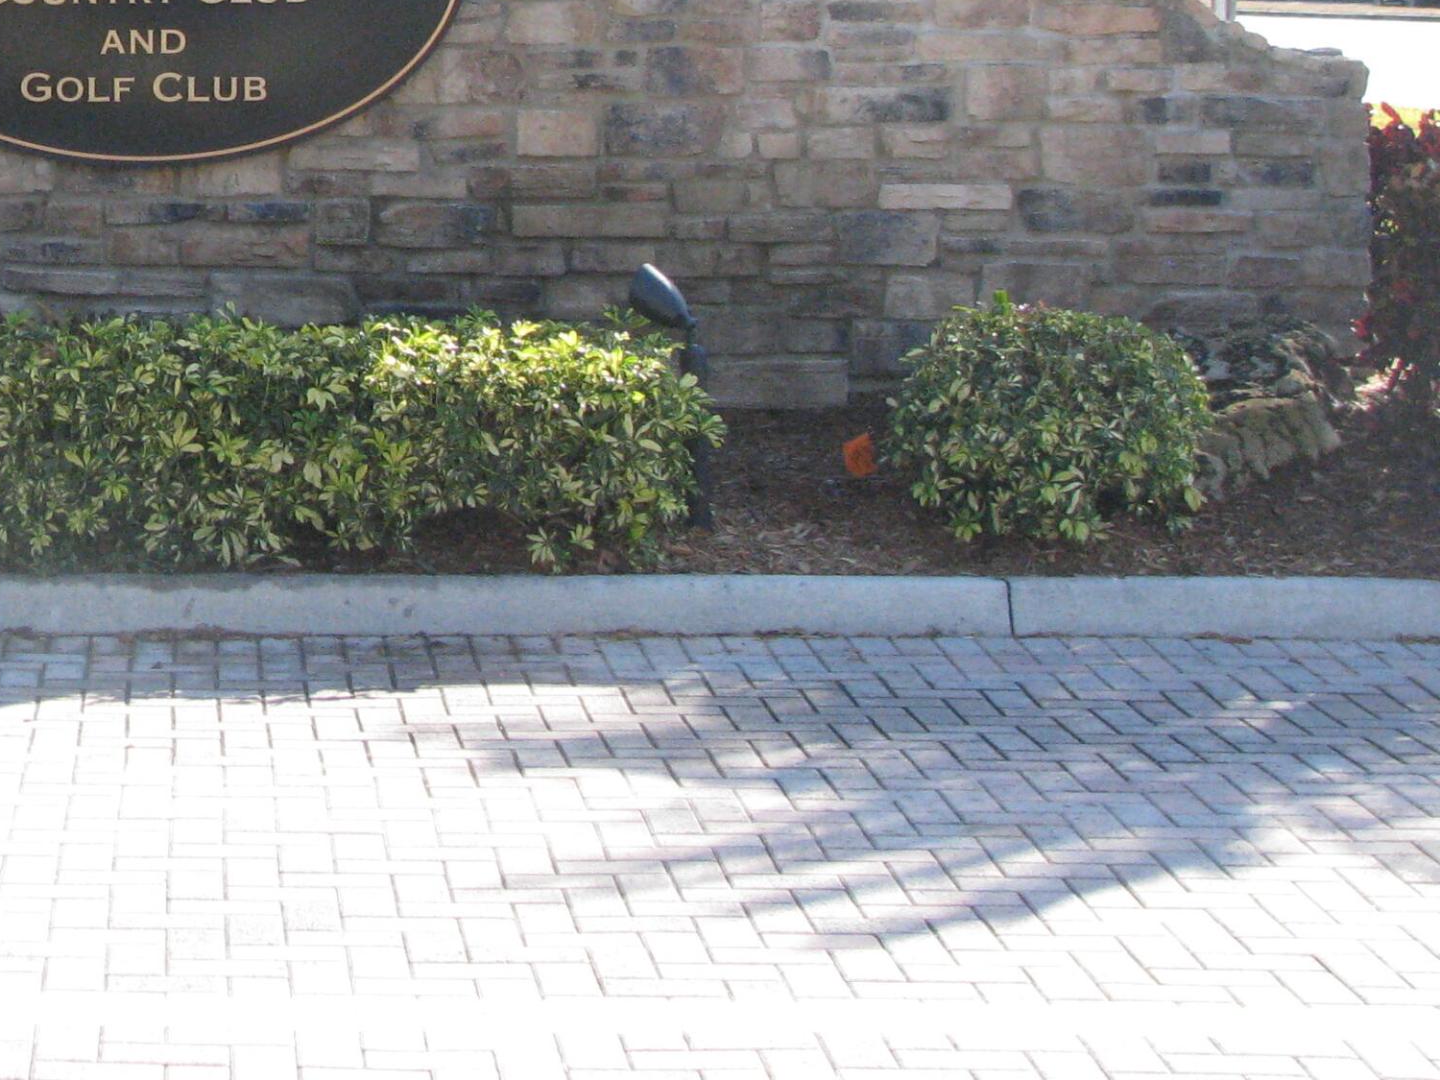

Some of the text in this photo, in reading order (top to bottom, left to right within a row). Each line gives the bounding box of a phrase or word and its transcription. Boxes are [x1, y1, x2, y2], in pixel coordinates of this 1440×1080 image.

[99, 28, 187, 55] AND
[20, 71, 268, 103] GOLF CLUB
